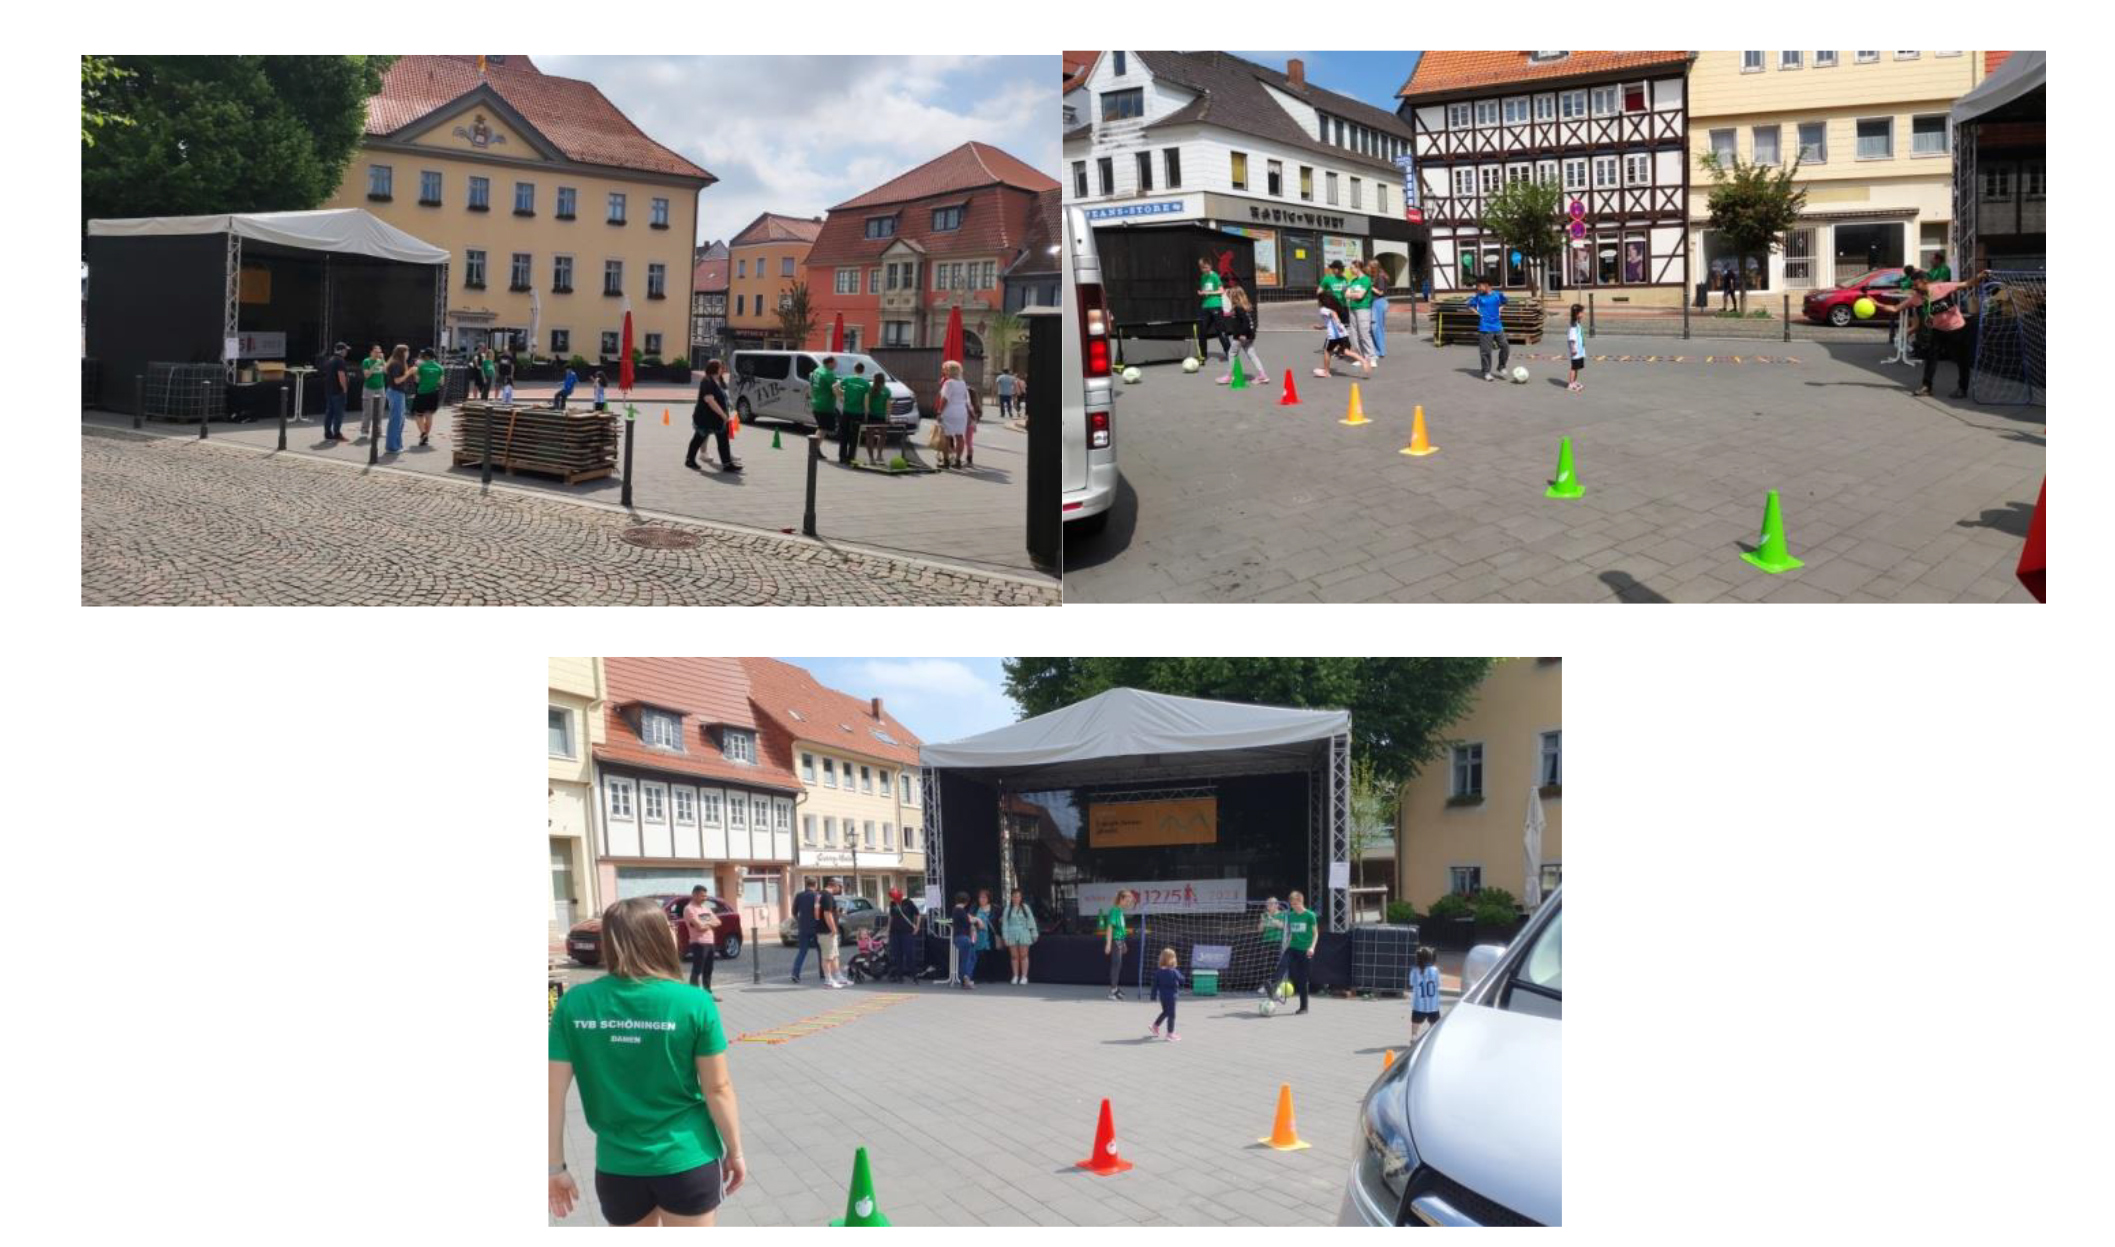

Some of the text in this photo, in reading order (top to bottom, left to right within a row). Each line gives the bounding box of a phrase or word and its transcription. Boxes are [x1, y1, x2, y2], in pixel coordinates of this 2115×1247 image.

[1145, 889, 1182, 904] 1275
[1419, 981, 1436, 998] 10
[574, 1019, 677, 1031] TVB SCHÖNINGEN
